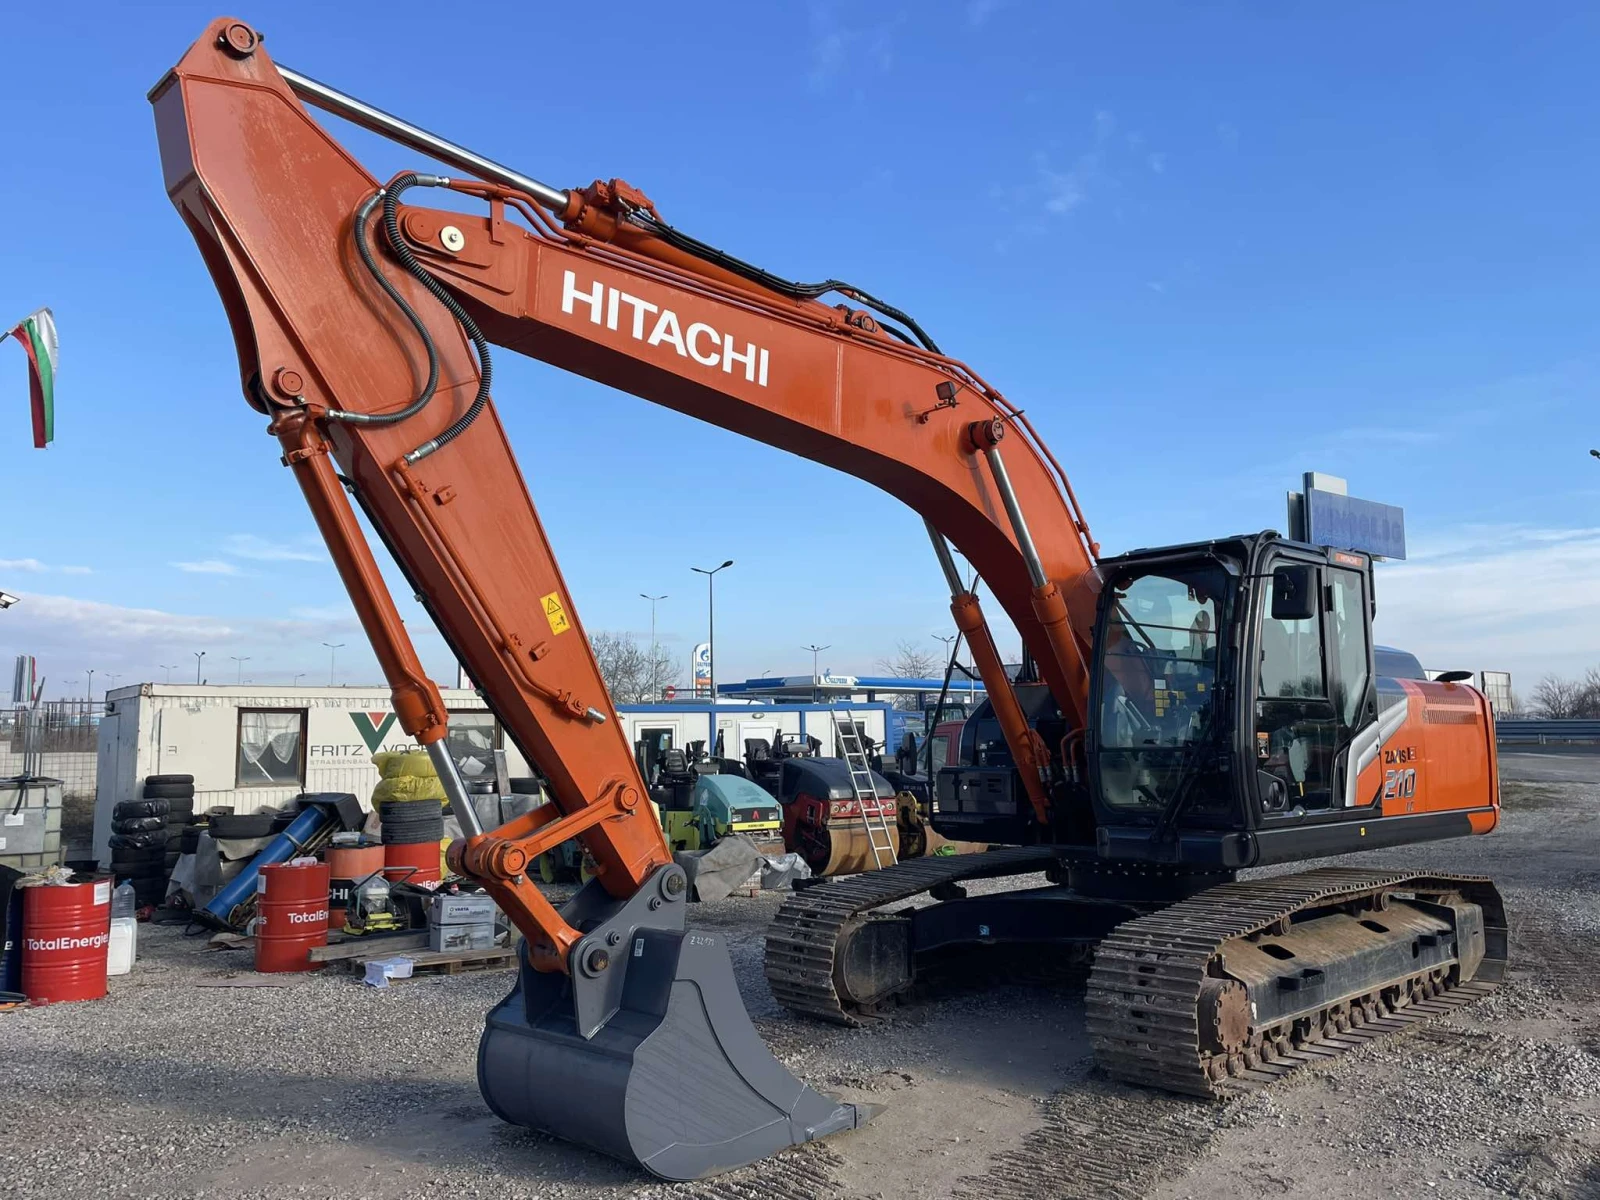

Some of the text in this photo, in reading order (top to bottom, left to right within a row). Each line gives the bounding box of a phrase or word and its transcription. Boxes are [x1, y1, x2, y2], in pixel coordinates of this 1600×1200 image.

[561, 269, 770, 388] HITACHI
[310, 745, 364, 757] FRITZ
[1384, 768, 1416, 800] 210
